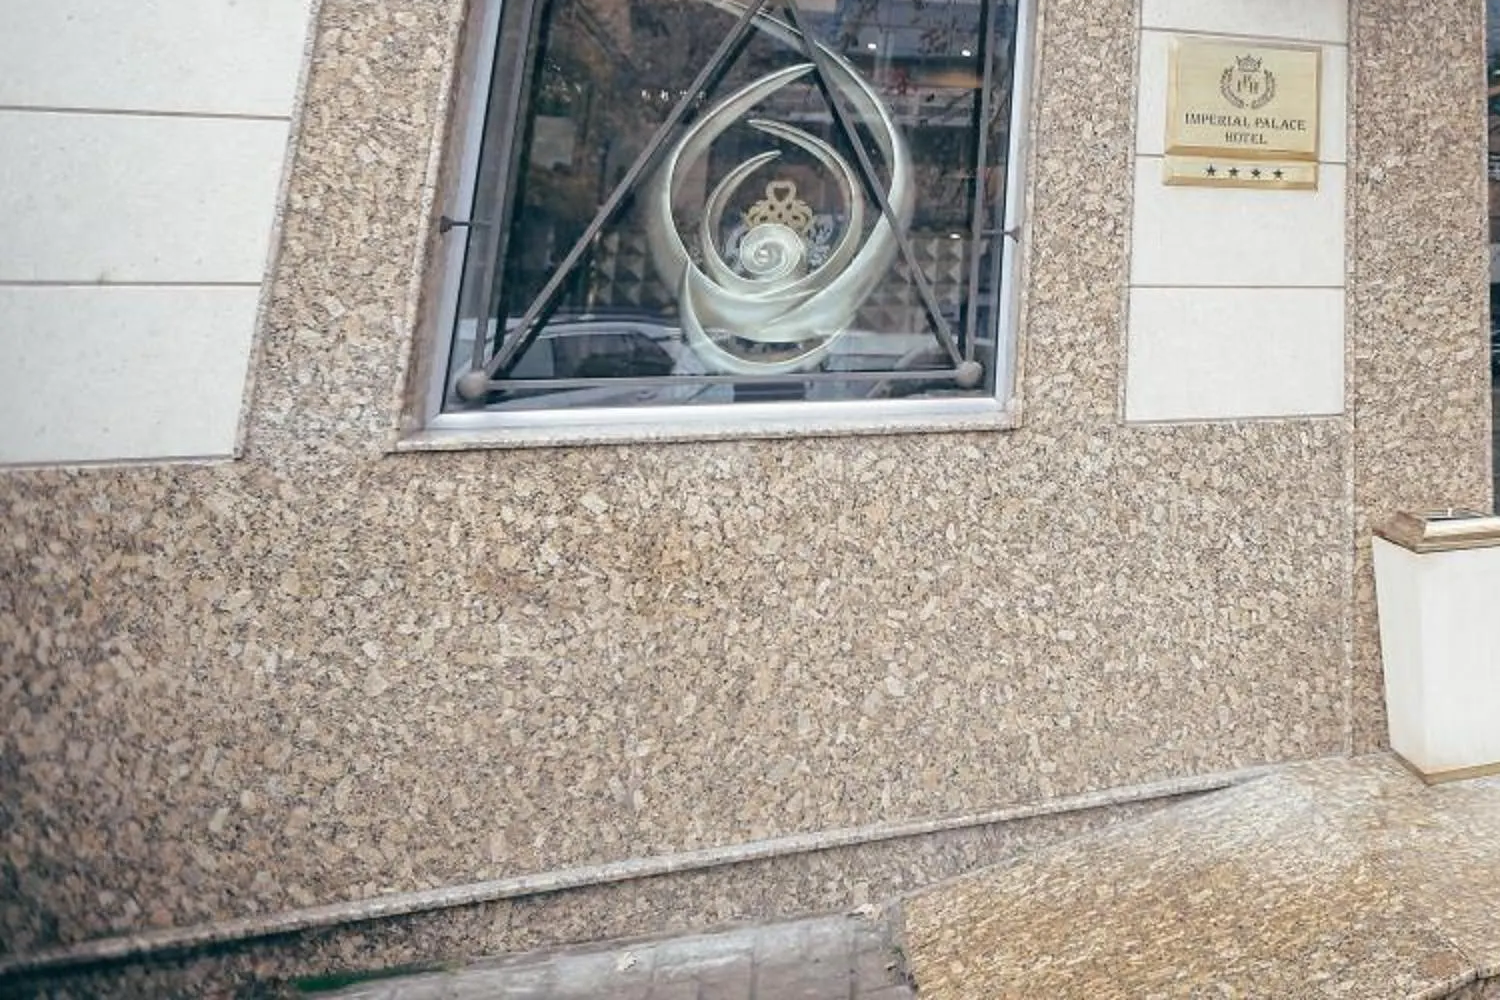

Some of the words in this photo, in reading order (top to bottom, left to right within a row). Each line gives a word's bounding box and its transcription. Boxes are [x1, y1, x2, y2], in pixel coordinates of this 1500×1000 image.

[1184, 112, 1250, 129] IMPERIAL
[1254, 117, 1307, 132] PALACE
[1225, 131, 1268, 145] HOTEL
